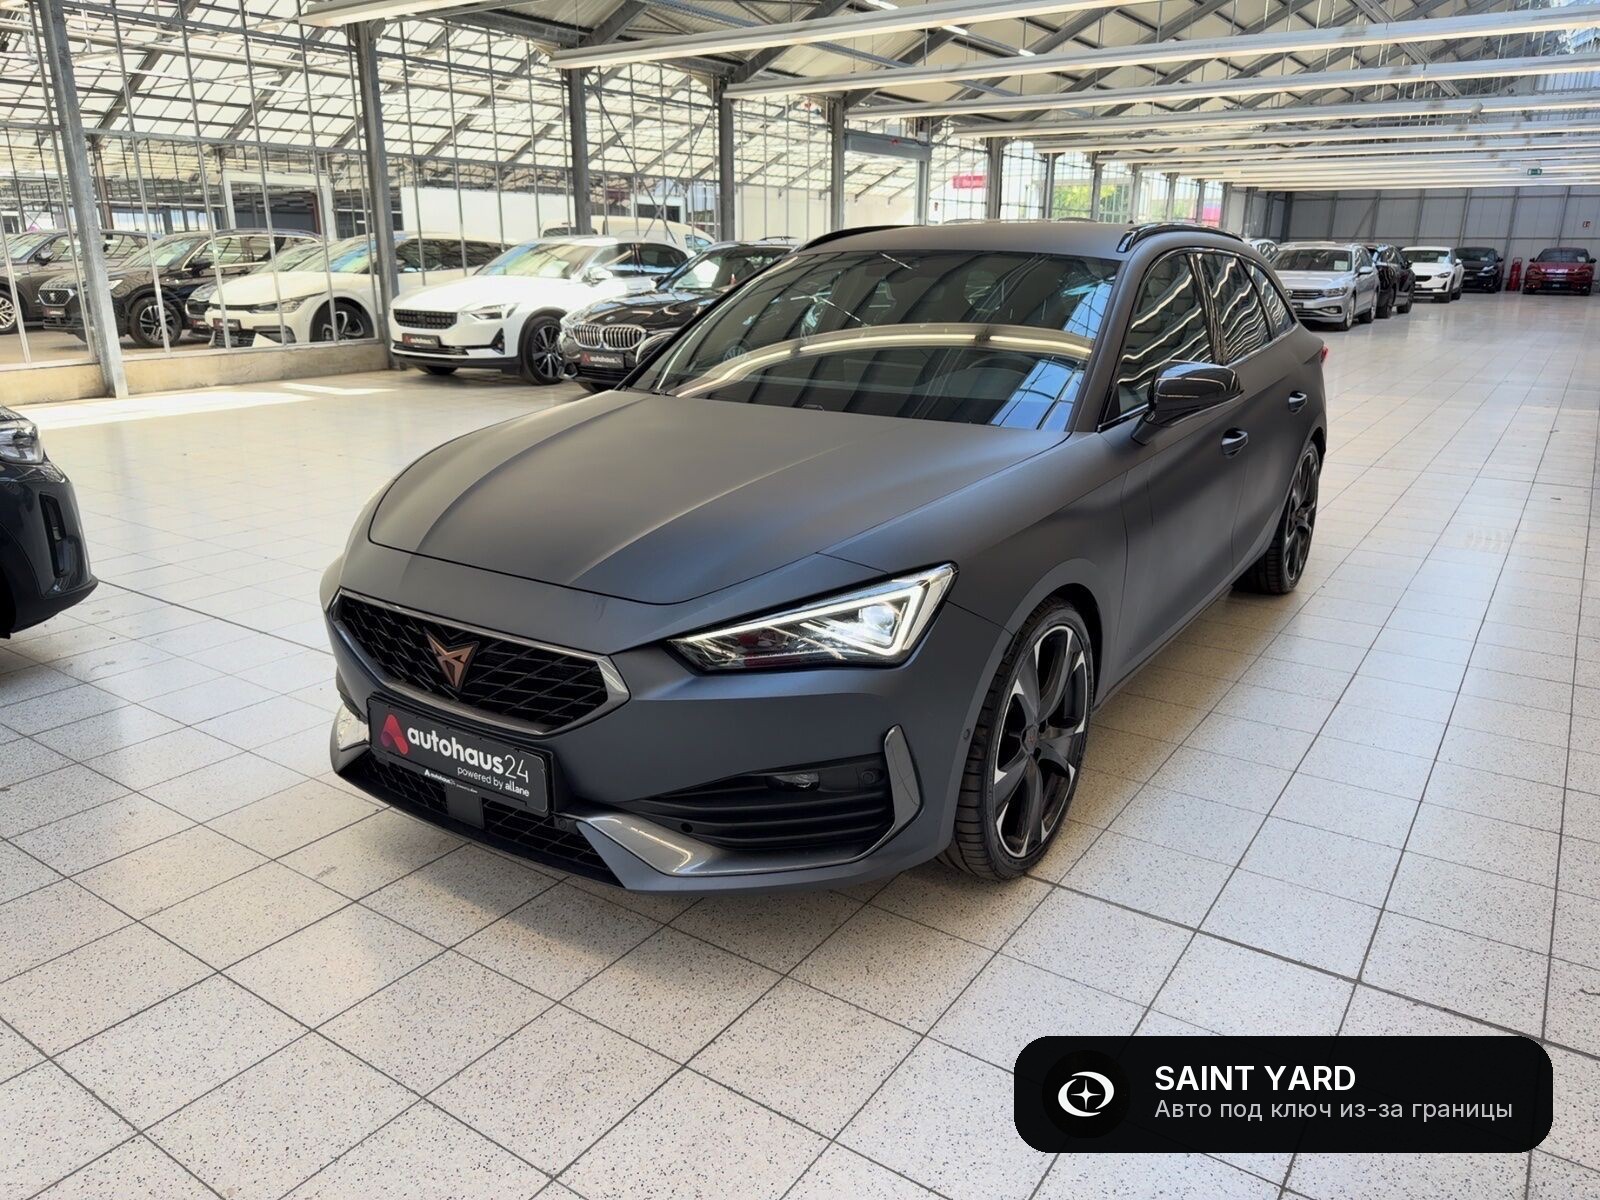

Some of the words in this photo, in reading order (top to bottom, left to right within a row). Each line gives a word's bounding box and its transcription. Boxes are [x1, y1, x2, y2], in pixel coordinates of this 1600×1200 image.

[407, 727, 530, 784] autohaus24
[457, 767, 492, 785] powered
[493, 776, 504, 790] by
[505, 780, 530, 797] allane
